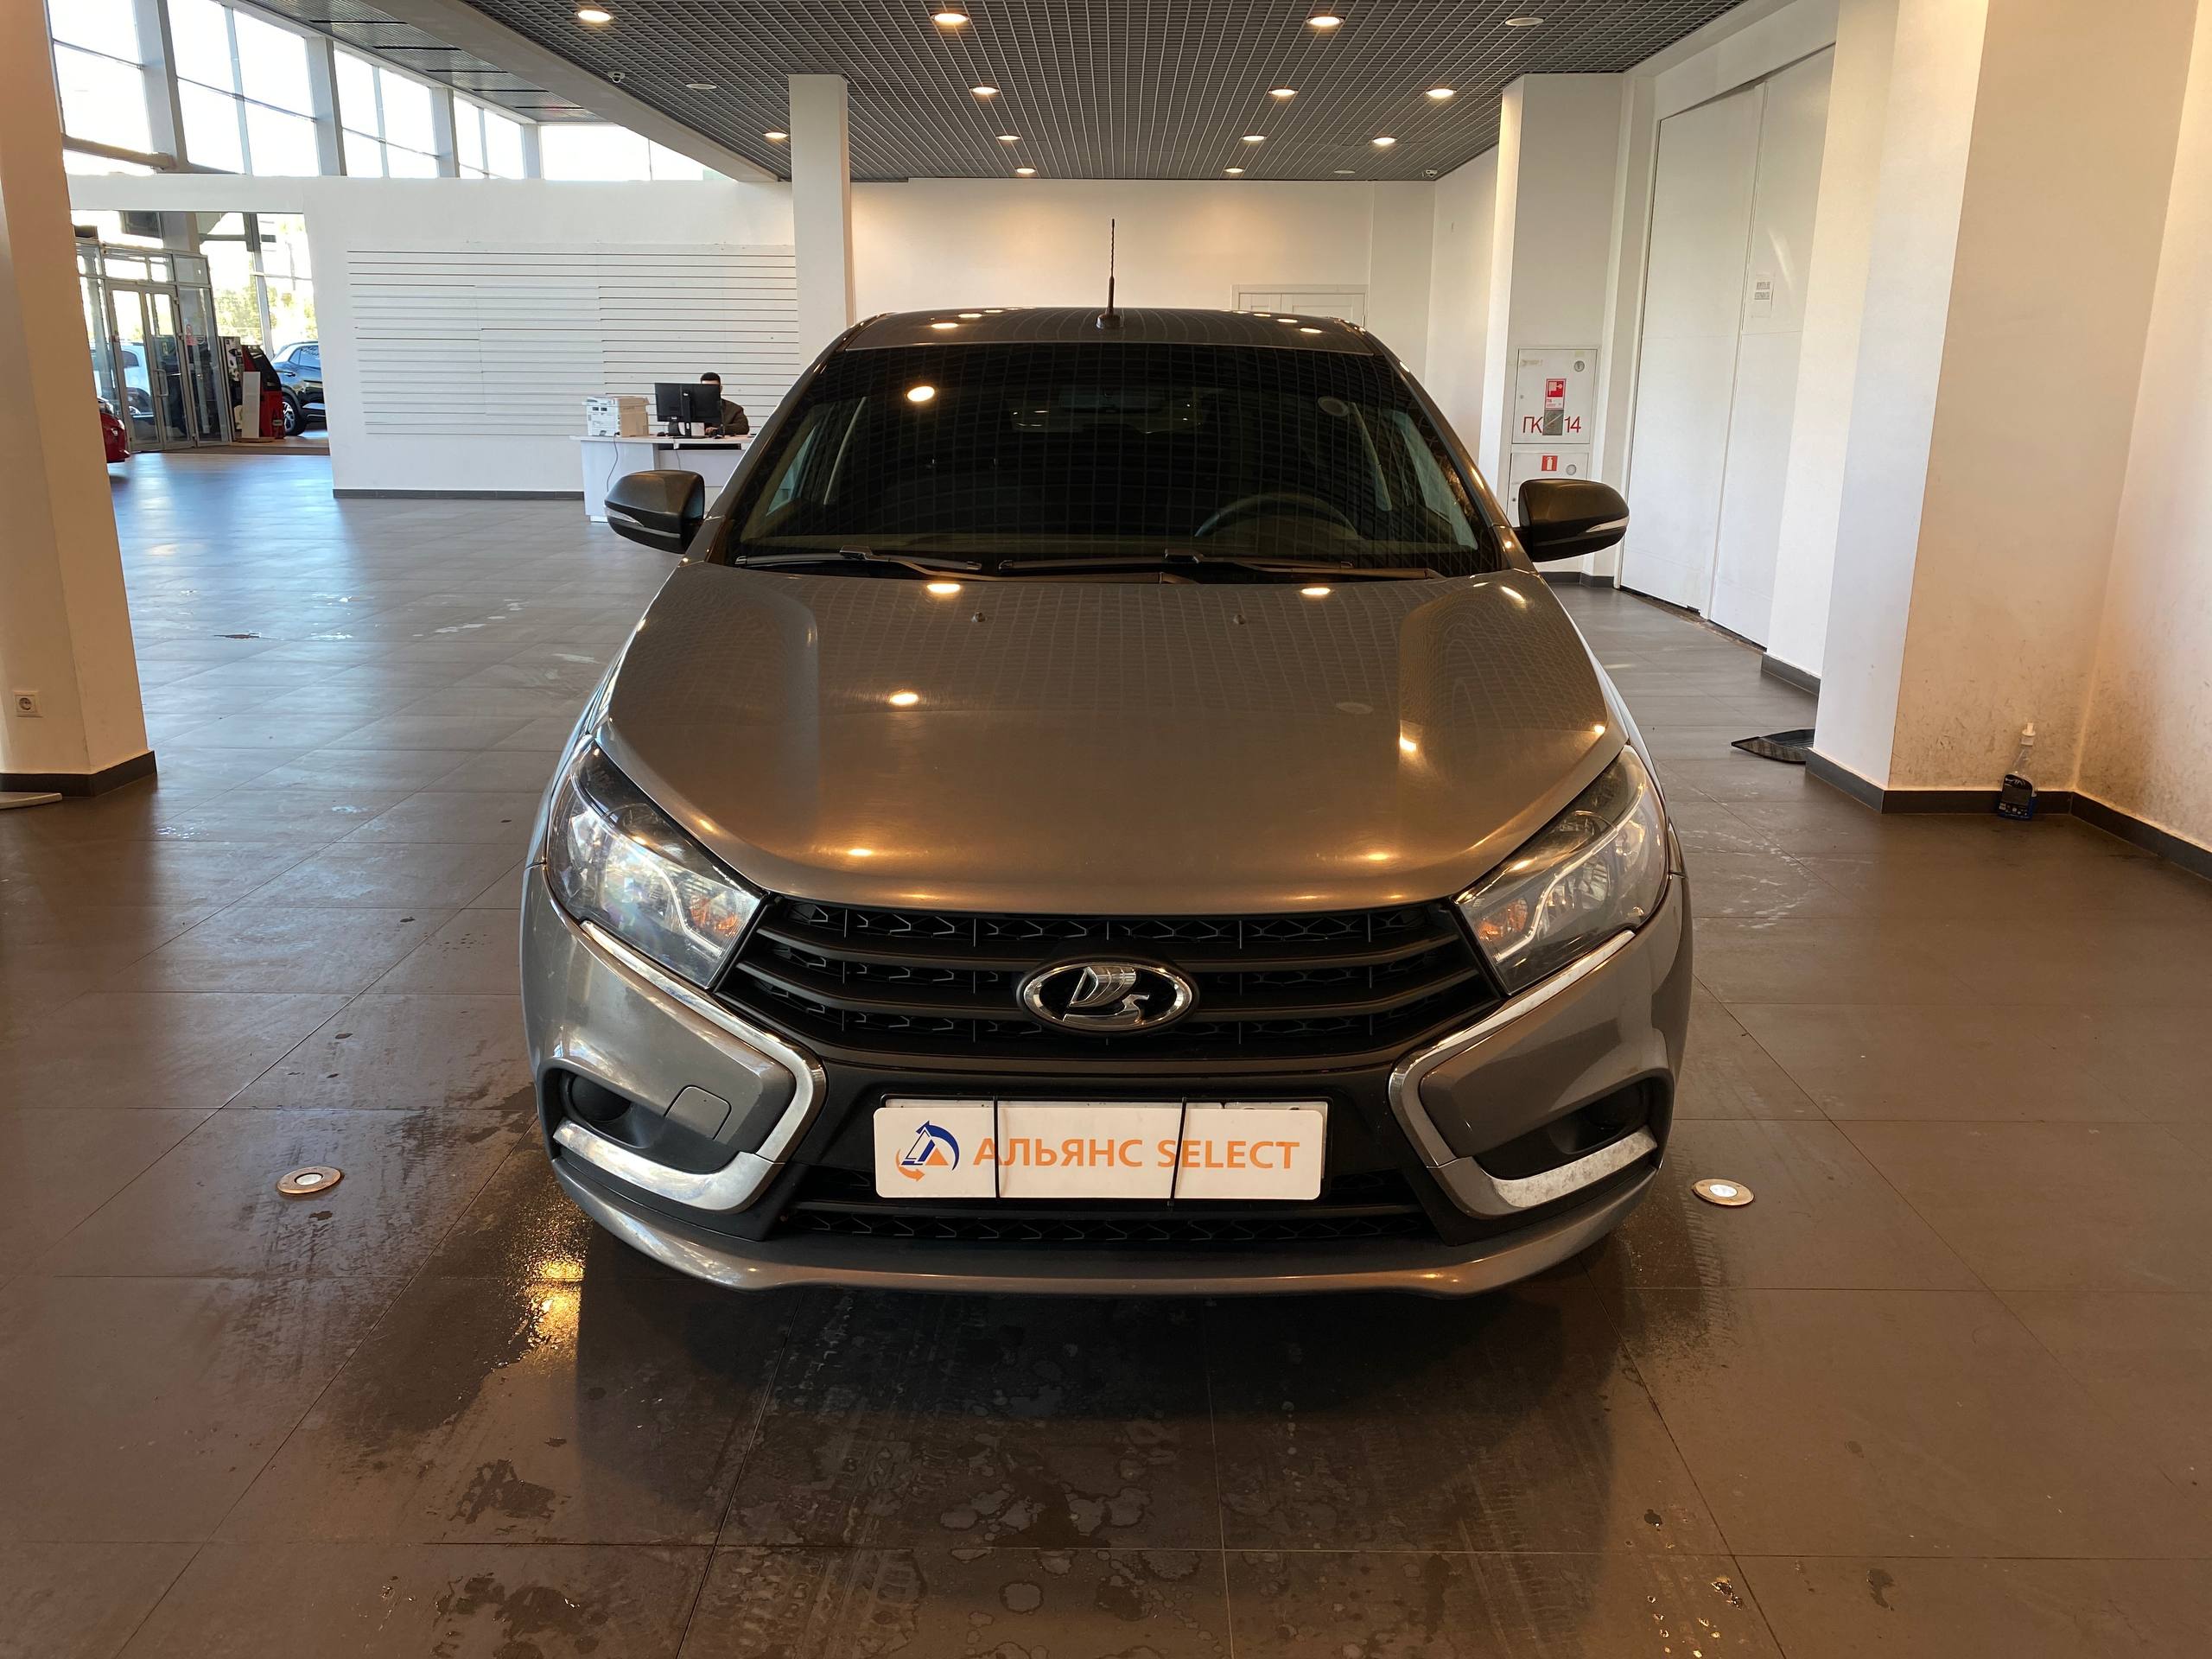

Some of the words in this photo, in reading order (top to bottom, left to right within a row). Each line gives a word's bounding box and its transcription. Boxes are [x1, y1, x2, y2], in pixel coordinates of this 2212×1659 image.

[1522, 416, 1543, 433] ПК
[1564, 416, 1582, 433] 14
[972, 1137, 1143, 1168] АЛЬЯНС
[1156, 1139, 1300, 1169] SELECT
